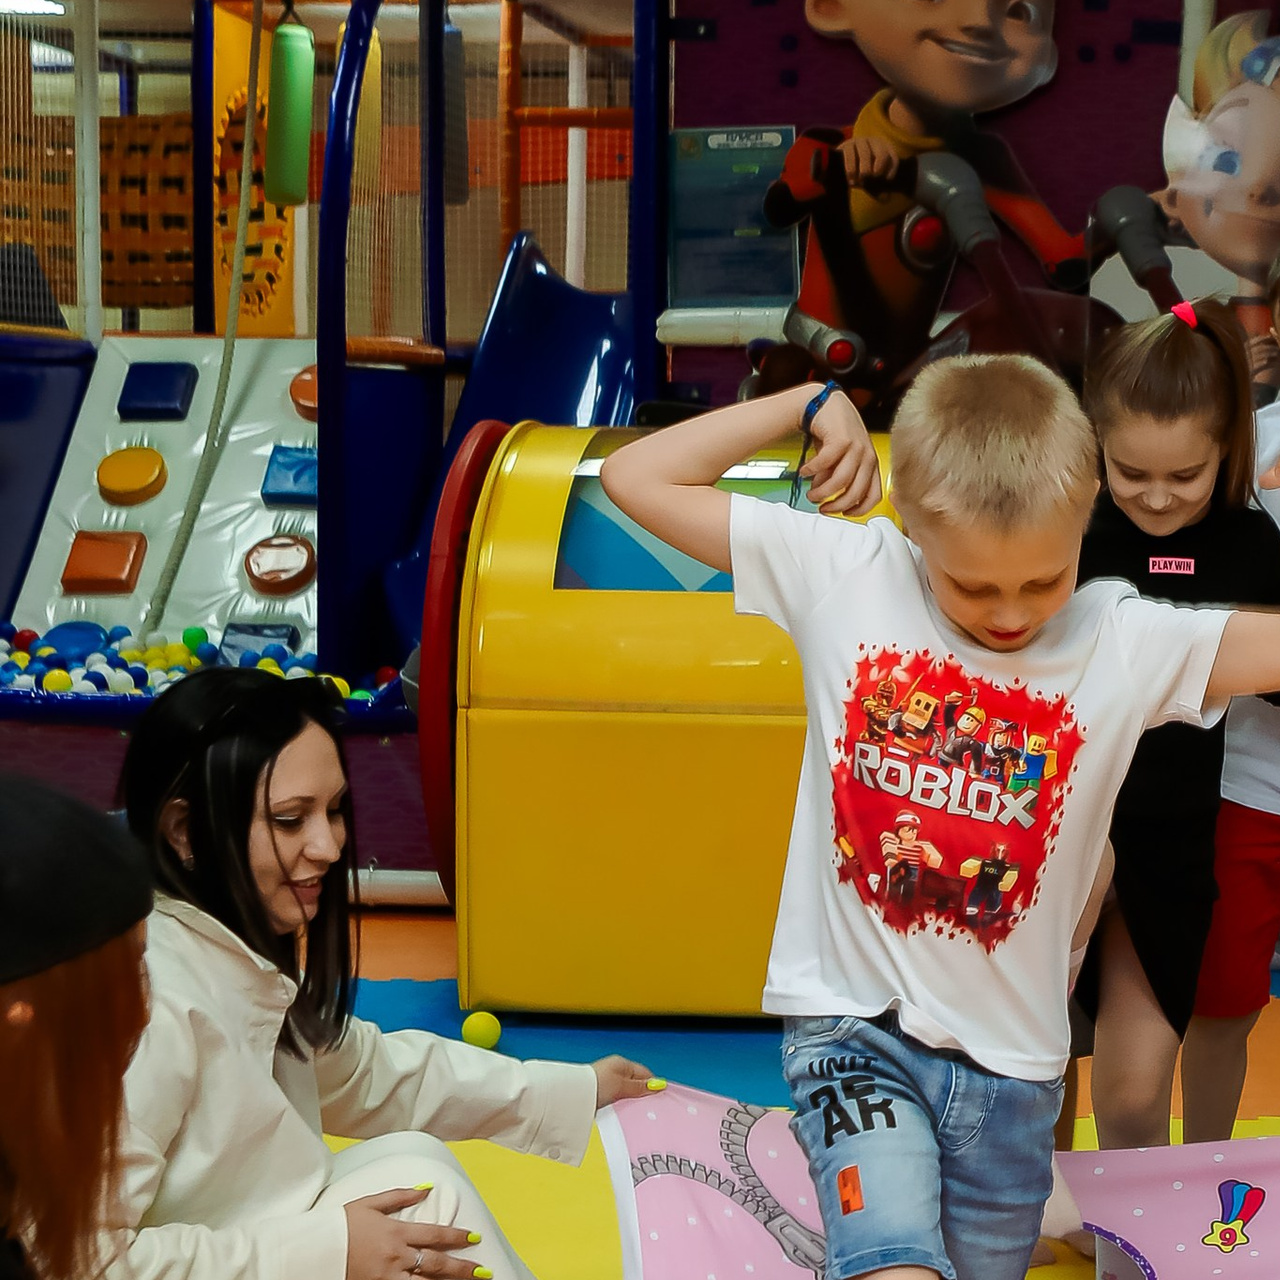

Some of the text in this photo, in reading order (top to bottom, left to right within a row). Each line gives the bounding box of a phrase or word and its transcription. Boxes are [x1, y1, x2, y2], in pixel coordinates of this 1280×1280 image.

[1151, 560, 1192, 572] PLAY WIN
[853, 742, 1039, 830] ROBLOX
[808, 1055, 878, 1077] UNIT
